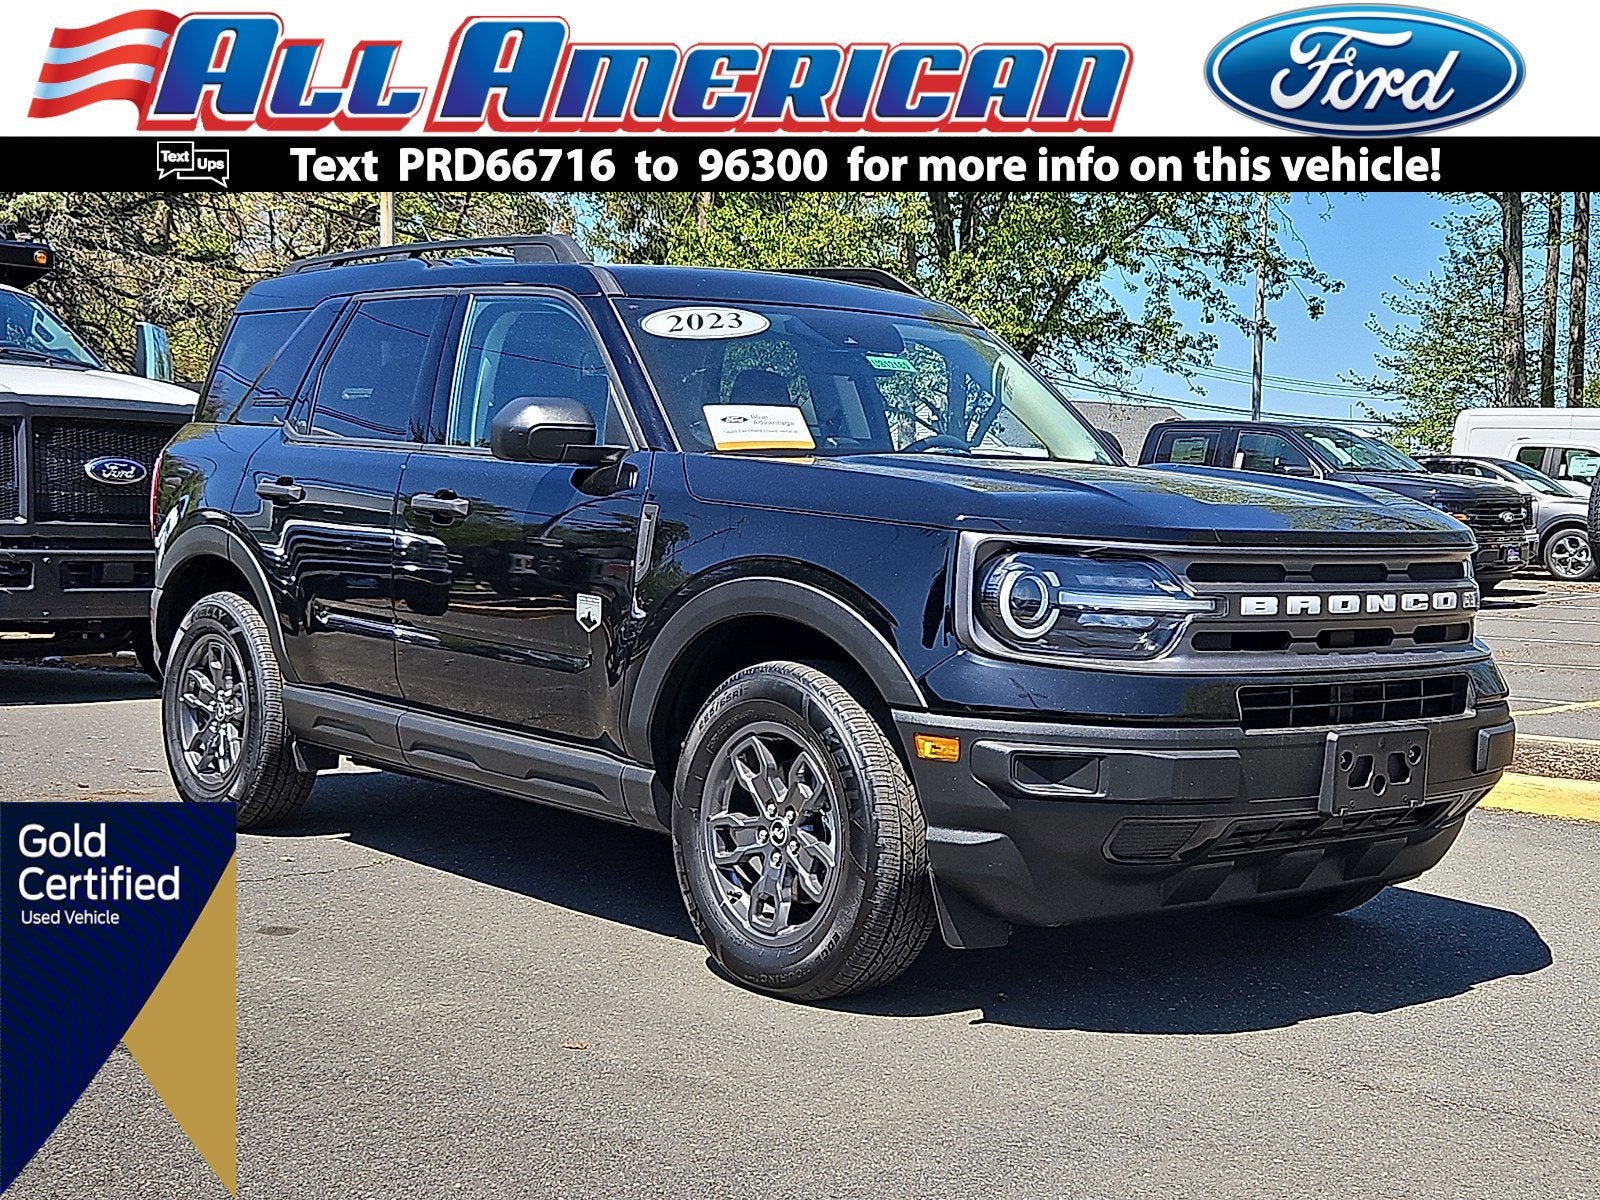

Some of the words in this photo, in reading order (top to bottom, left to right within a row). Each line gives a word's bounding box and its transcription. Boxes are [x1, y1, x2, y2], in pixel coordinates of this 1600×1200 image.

[668, 312, 743, 333] 2023
[102, 463, 136, 479] Ford
[1240, 591, 1457, 616] BRONCO
